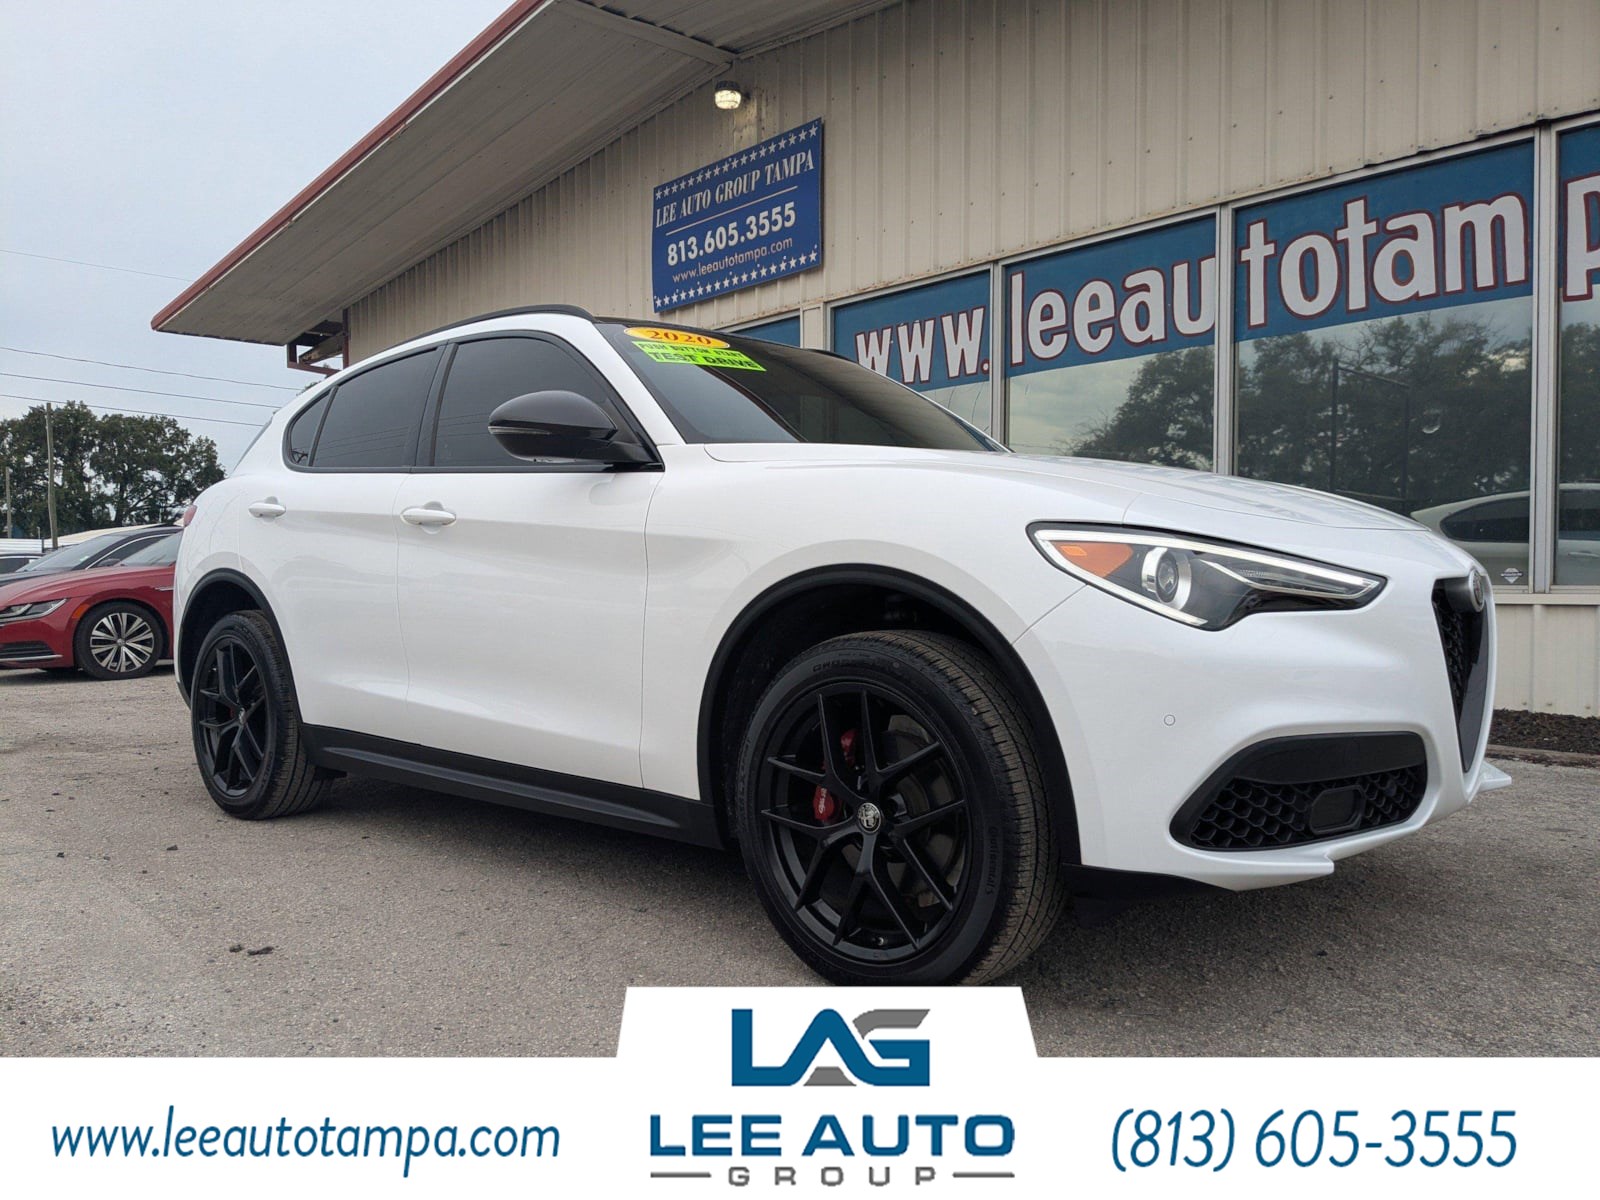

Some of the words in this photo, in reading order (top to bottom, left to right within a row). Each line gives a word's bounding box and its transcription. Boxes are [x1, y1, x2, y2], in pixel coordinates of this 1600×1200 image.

[655, 202, 677, 228] LEE
[680, 189, 711, 218] AUTO
[715, 169, 760, 204] GROUP
[765, 148, 815, 186] TAMPA
[667, 201, 796, 266] 813.605.3555
[672, 237, 793, 284] www.leeautotampa.com
[646, 330, 712, 345] 2020
[648, 352, 698, 362] TEST
[703, 355, 759, 368] DRIVE
